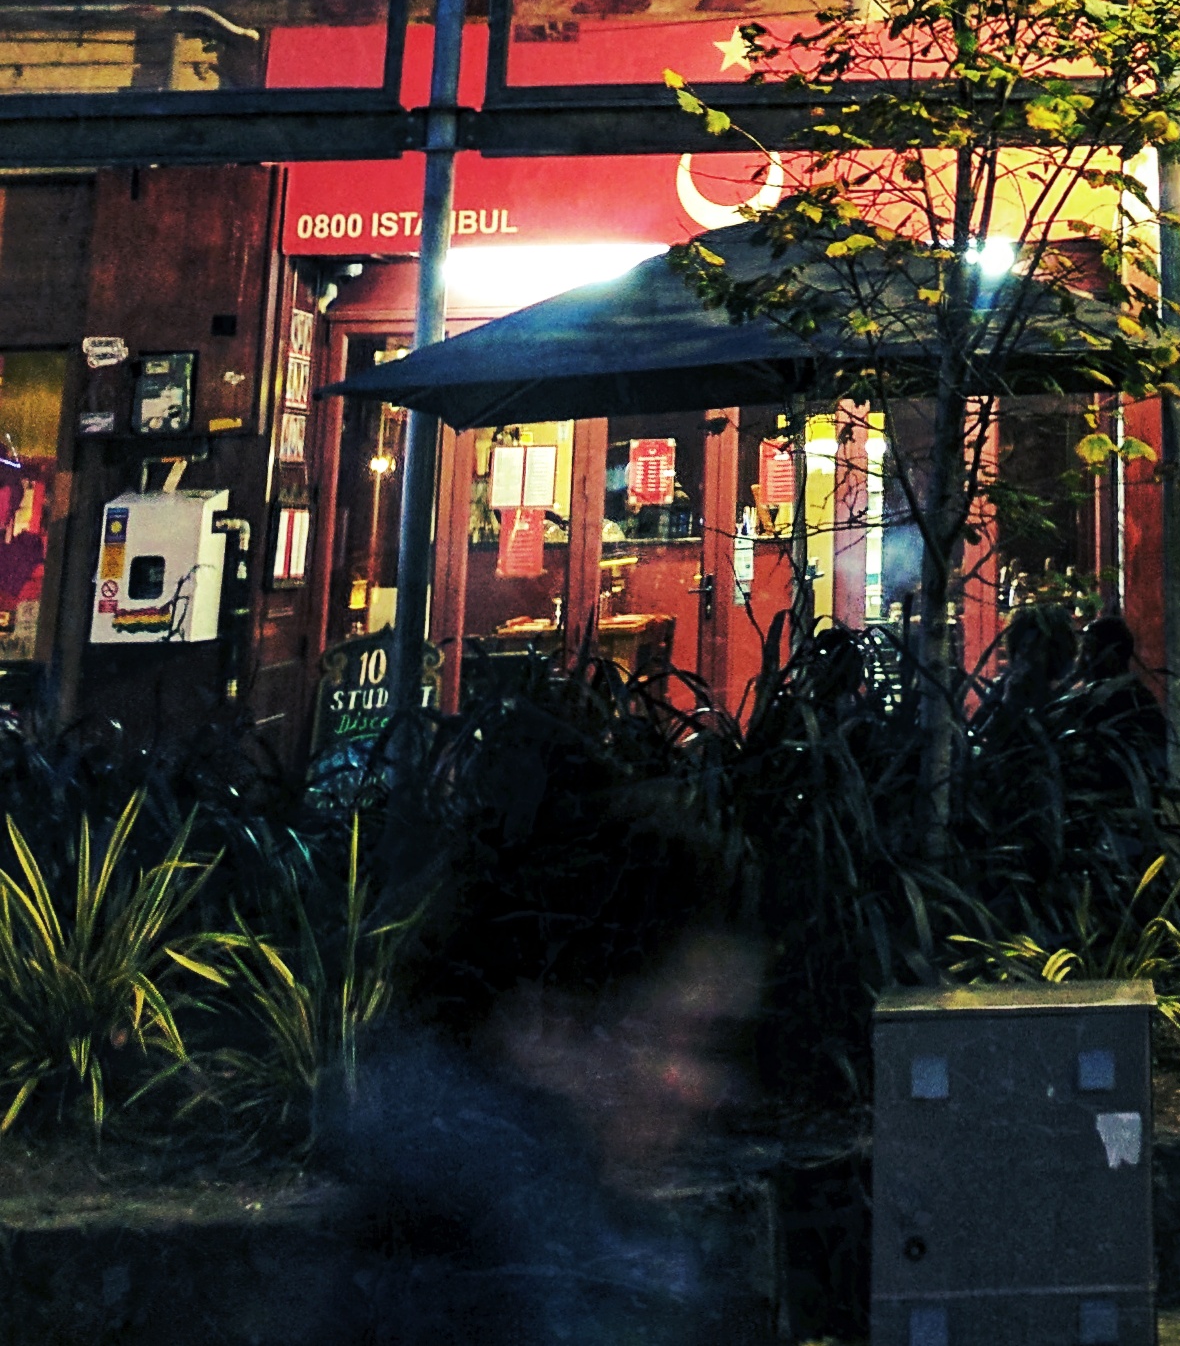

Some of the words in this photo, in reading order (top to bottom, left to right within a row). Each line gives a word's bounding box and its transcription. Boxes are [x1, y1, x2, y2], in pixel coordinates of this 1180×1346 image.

[296, 213, 363, 240] 0800
[370, 208, 519, 238] ISTBUL
[329, 685, 434, 712] STUDT
